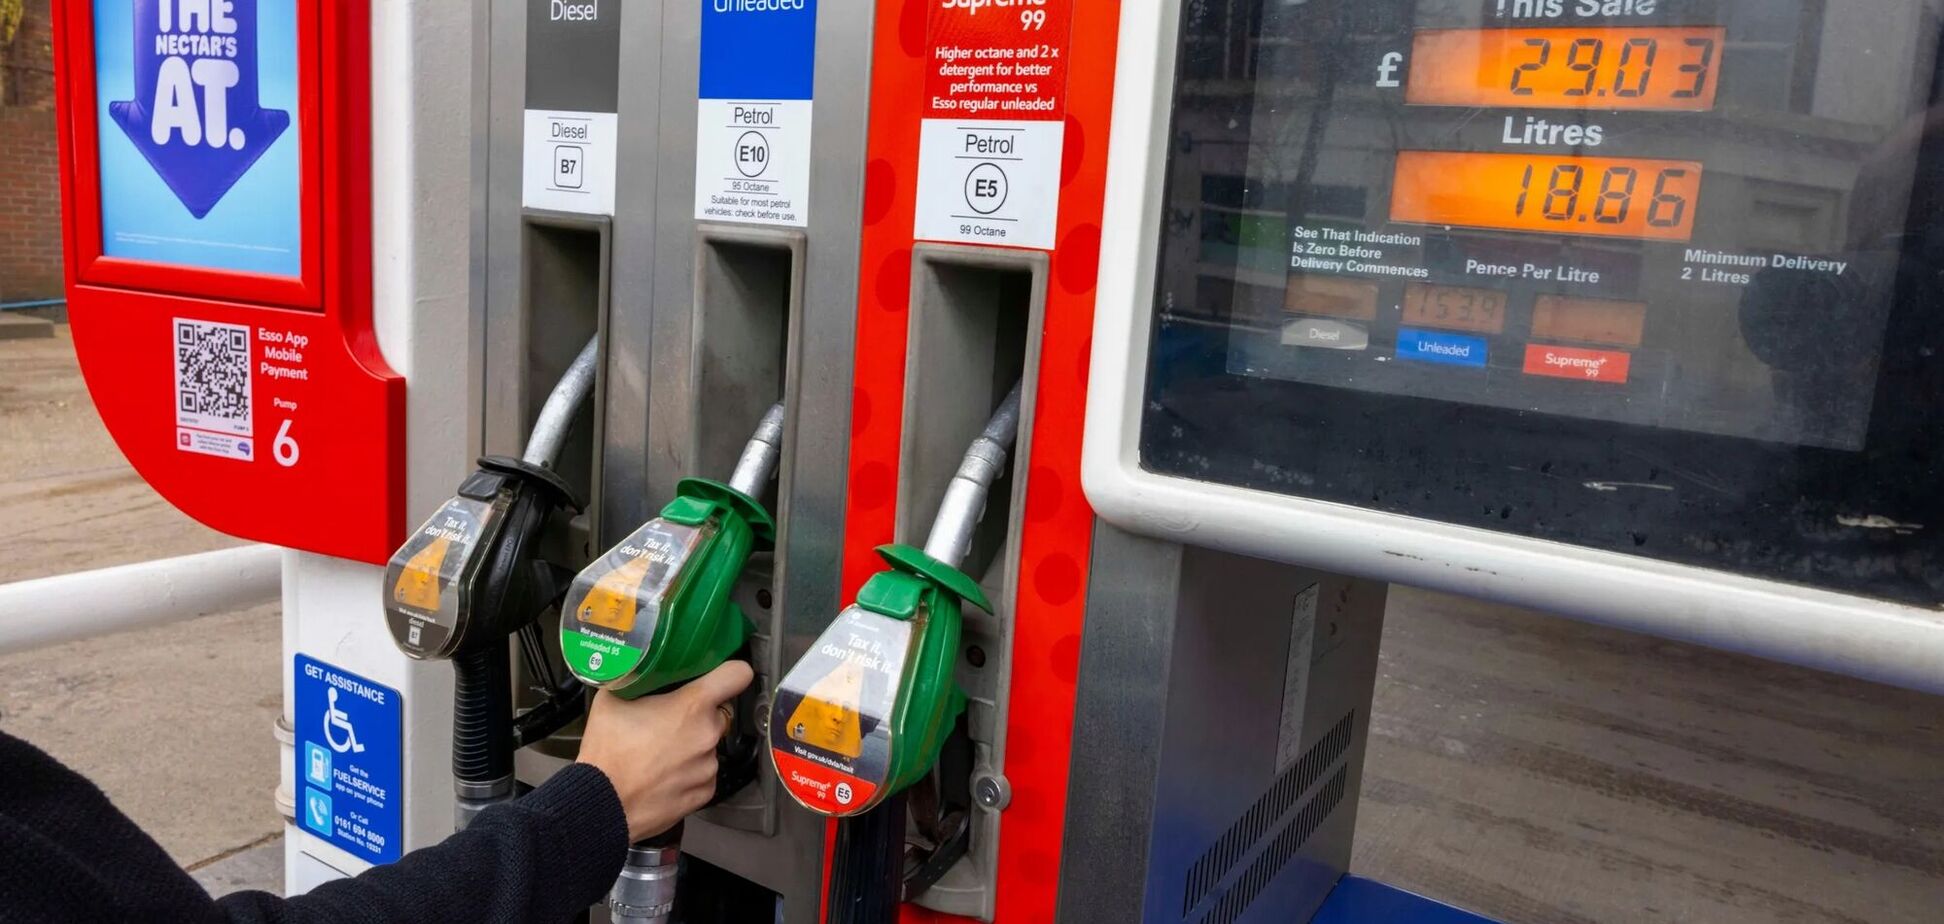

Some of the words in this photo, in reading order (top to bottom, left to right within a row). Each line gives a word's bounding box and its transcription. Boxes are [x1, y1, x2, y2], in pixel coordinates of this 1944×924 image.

[551, 0, 597, 20] Diesel
[1020, 10, 1046, 31] 99
[155, 35, 237, 57] NECTAR'S
[935, 46, 973, 62] Higher
[975, 47, 1014, 59] octane
[1016, 45, 1039, 58] and
[1040, 45, 1049, 58] 2
[1051, 48, 1059, 57] x
[939, 63, 994, 79] detergent
[996, 62, 1013, 75] for
[1015, 62, 1052, 75] better
[1375, 52, 1403, 87] £
[1510, 38, 1714, 98] 29.03
[950, 80, 1022, 95] performance
[1025, 83, 1038, 93] vs
[151, 56, 246, 151] AT.
[932, 97, 957, 109] Esso
[960, 97, 999, 113] regular
[1001, 97, 1056, 110] unleaded
[734, 107, 774, 125] Petrol
[552, 122, 588, 139] Diesel
[1502, 116, 1604, 146] Litres
[965, 134, 1014, 154] Petrol
[740, 146, 765, 162] E10
[561, 159, 576, 174] B7
[732, 181, 741, 190] 95
[743, 182, 770, 192] Octane
[975, 179, 998, 198] E5
[711, 195, 739, 205] Suitable
[740, 197, 750, 206] for
[751, 199, 769, 207] most
[770, 200, 791, 209] petrol
[1515, 164, 1688, 227] 18.86
[735, 209, 755, 218] check
[757, 210, 780, 219] before
[960, 224, 972, 235] 99
[974, 225, 1006, 237] Octane
[1294, 226, 1318, 239] See
[1322, 228, 1351, 241] That
[1354, 230, 1421, 246] Indication
[1293, 242, 1304, 253] Is
[1307, 243, 1336, 256] Zero
[1339, 245, 1382, 259] Before
[1291, 256, 1343, 273] Delivery
[1346, 260, 1429, 278] Commences
[1466, 259, 1518, 277] Pence
[1522, 263, 1552, 280] Per
[1556, 266, 1600, 283] Litre
[1684, 249, 1766, 267] Minimum
[1772, 254, 1847, 276] Delivery
[1681, 267, 1692, 280] 2
[1701, 268, 1750, 284] Litres
[258, 328, 283, 342] Esso
[285, 331, 309, 349] App
[1309, 328, 1340, 341] Diesel
[265, 346, 302, 362] Mobile
[1418, 341, 1470, 357] Unleaded
[261, 362, 309, 380] Payment
[1585, 369, 1599, 377] 99
[273, 397, 298, 412] Pump
[272, 419, 300, 467] 6
[444, 517, 460, 528] Tax
[644, 538, 662, 550] Tax
[644, 551, 666, 563] risk
[847, 632, 870, 650] Tax
[854, 653, 881, 670] risk
[305, 663, 324, 680] GET
[325, 671, 385, 705] ASSISTANCE
[794, 745, 807, 756] Visit
[333, 768, 386, 800] FUELSERVICE
[817, 790, 826, 800] 99
[838, 787, 850, 800] E5
